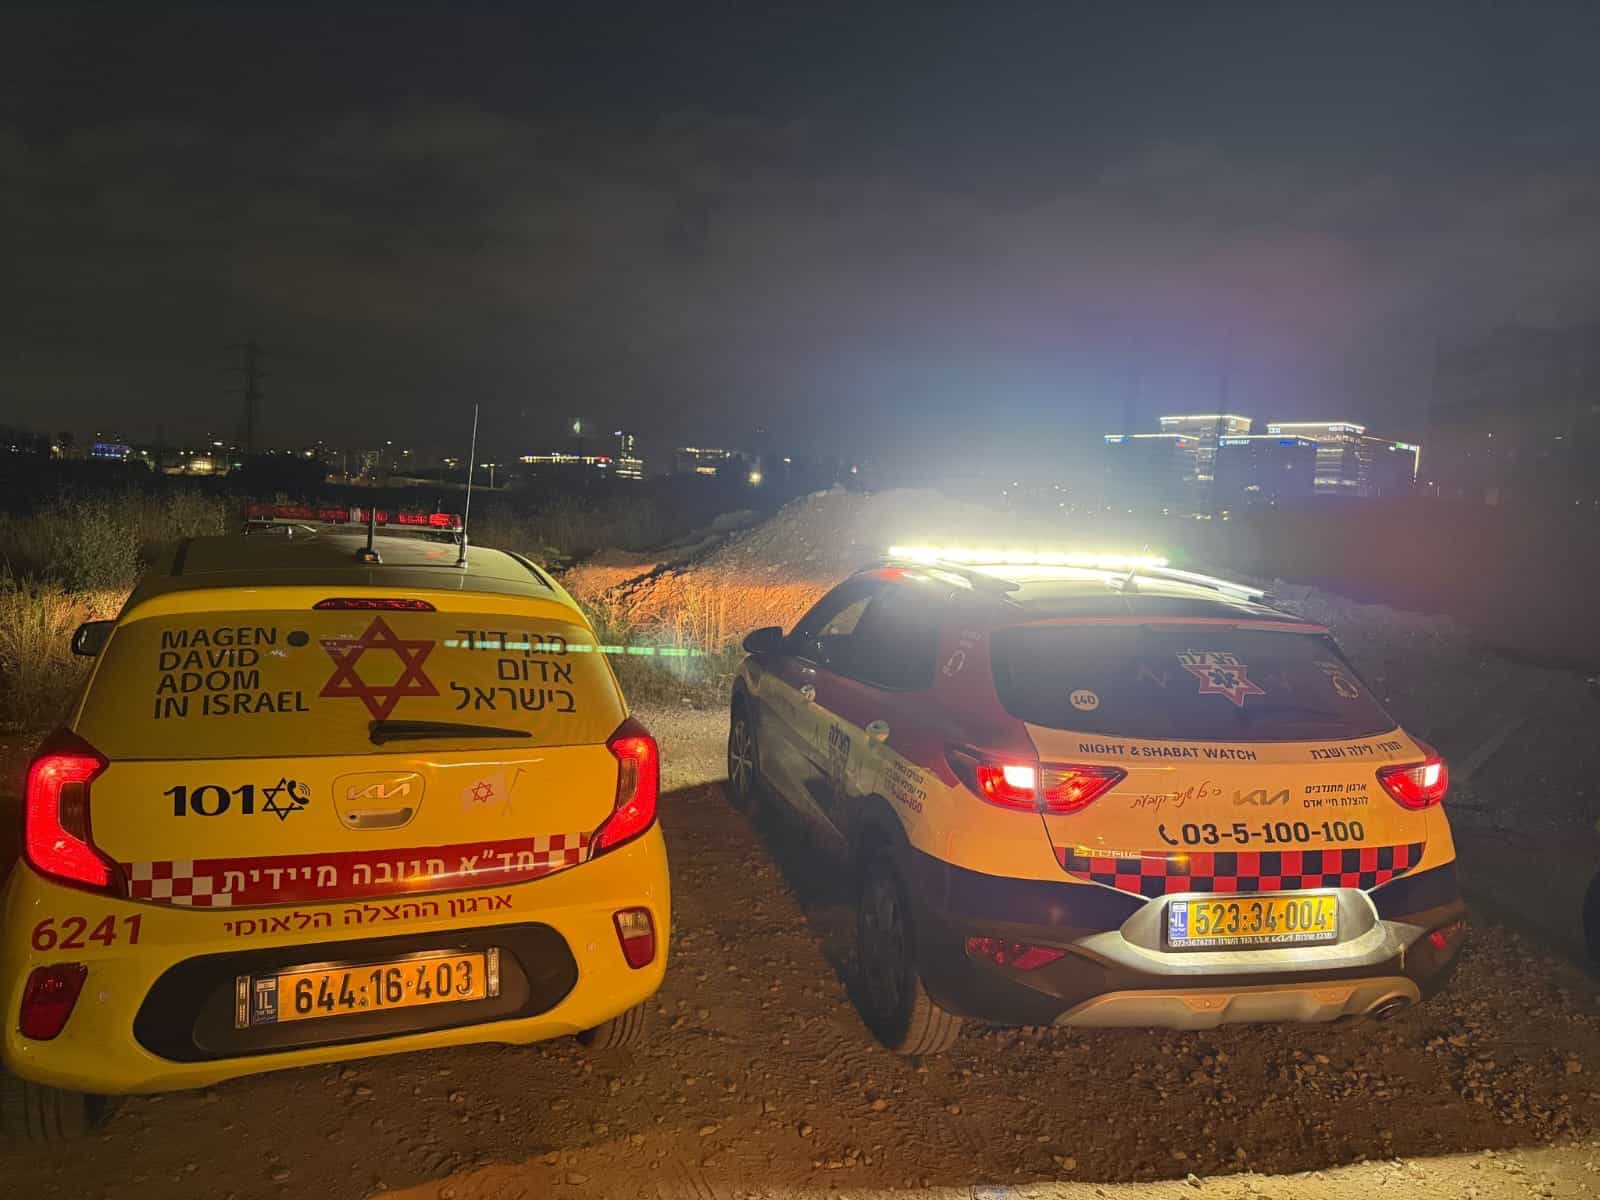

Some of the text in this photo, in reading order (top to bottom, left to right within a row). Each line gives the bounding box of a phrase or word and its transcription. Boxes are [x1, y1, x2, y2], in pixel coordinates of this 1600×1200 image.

[161, 627, 277, 649] MAGEN
[456, 630, 568, 657] מגן דוד
[159, 648, 260, 671] DAVID
[497, 658, 573, 684] אדום
[156, 670, 259, 694] ADOM
[154, 691, 310, 719] IN ISRAEL
[450, 681, 576, 713] בישראל
[1073, 695, 1096, 705] 140
[1078, 743, 1257, 761] NIGHT & SHABAT WATCH
[1310, 747, 1346, 760] ושבת
[164, 784, 254, 816] 101
[1305, 783, 1368, 794] ארגון מתנדבים
[1303, 799, 1322, 808] אדם
[1182, 821, 1364, 845] 03-5-100-100
[222, 865, 337, 893] מיידית
[352, 857, 445, 885] תגובה
[224, 894, 513, 936] ארגון ההצלה הלאומי
[32, 913, 142, 951] 6241
